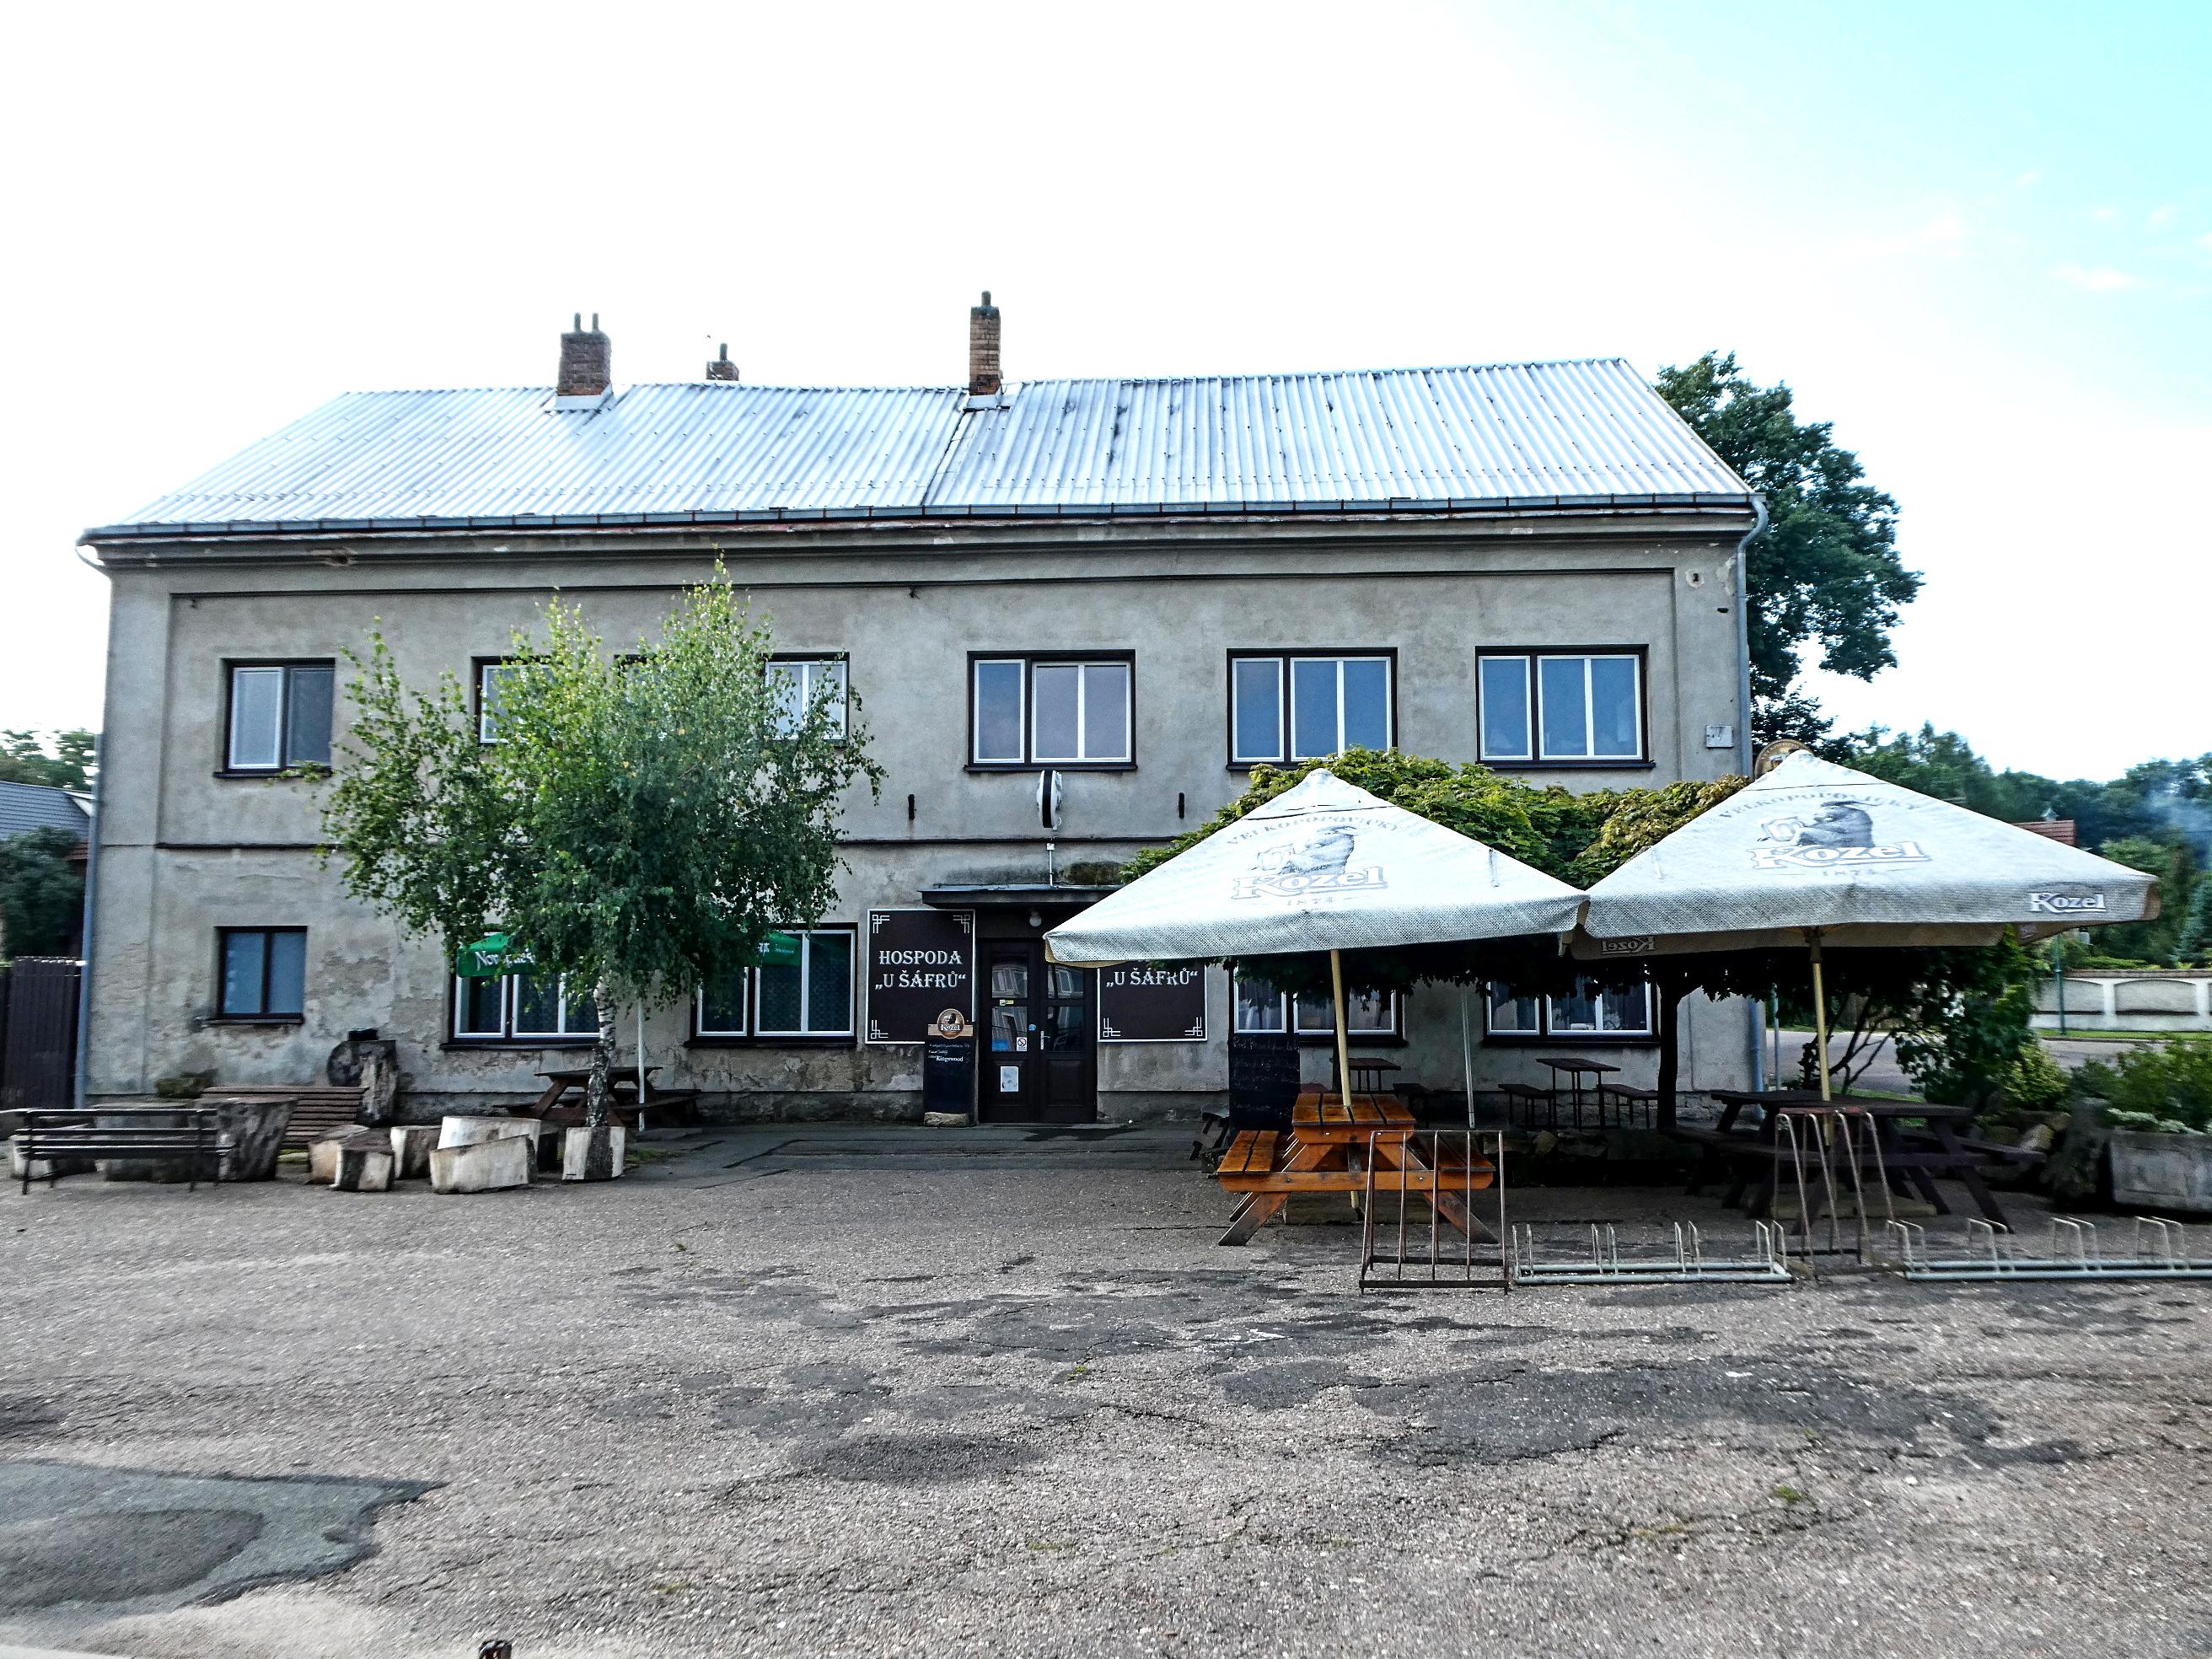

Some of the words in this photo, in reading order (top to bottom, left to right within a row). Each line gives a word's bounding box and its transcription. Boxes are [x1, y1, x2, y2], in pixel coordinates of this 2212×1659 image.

[1748, 840, 1933, 870] Kozel
[1231, 866, 1388, 899] Kozel
[2027, 891, 2107, 915] Kozel
[878, 950, 964, 965] HOSPODA
[875, 974, 894, 990] „U
[898, 969, 966, 988] ŠÁFRŮ“
[1106, 971, 1125, 987] „U
